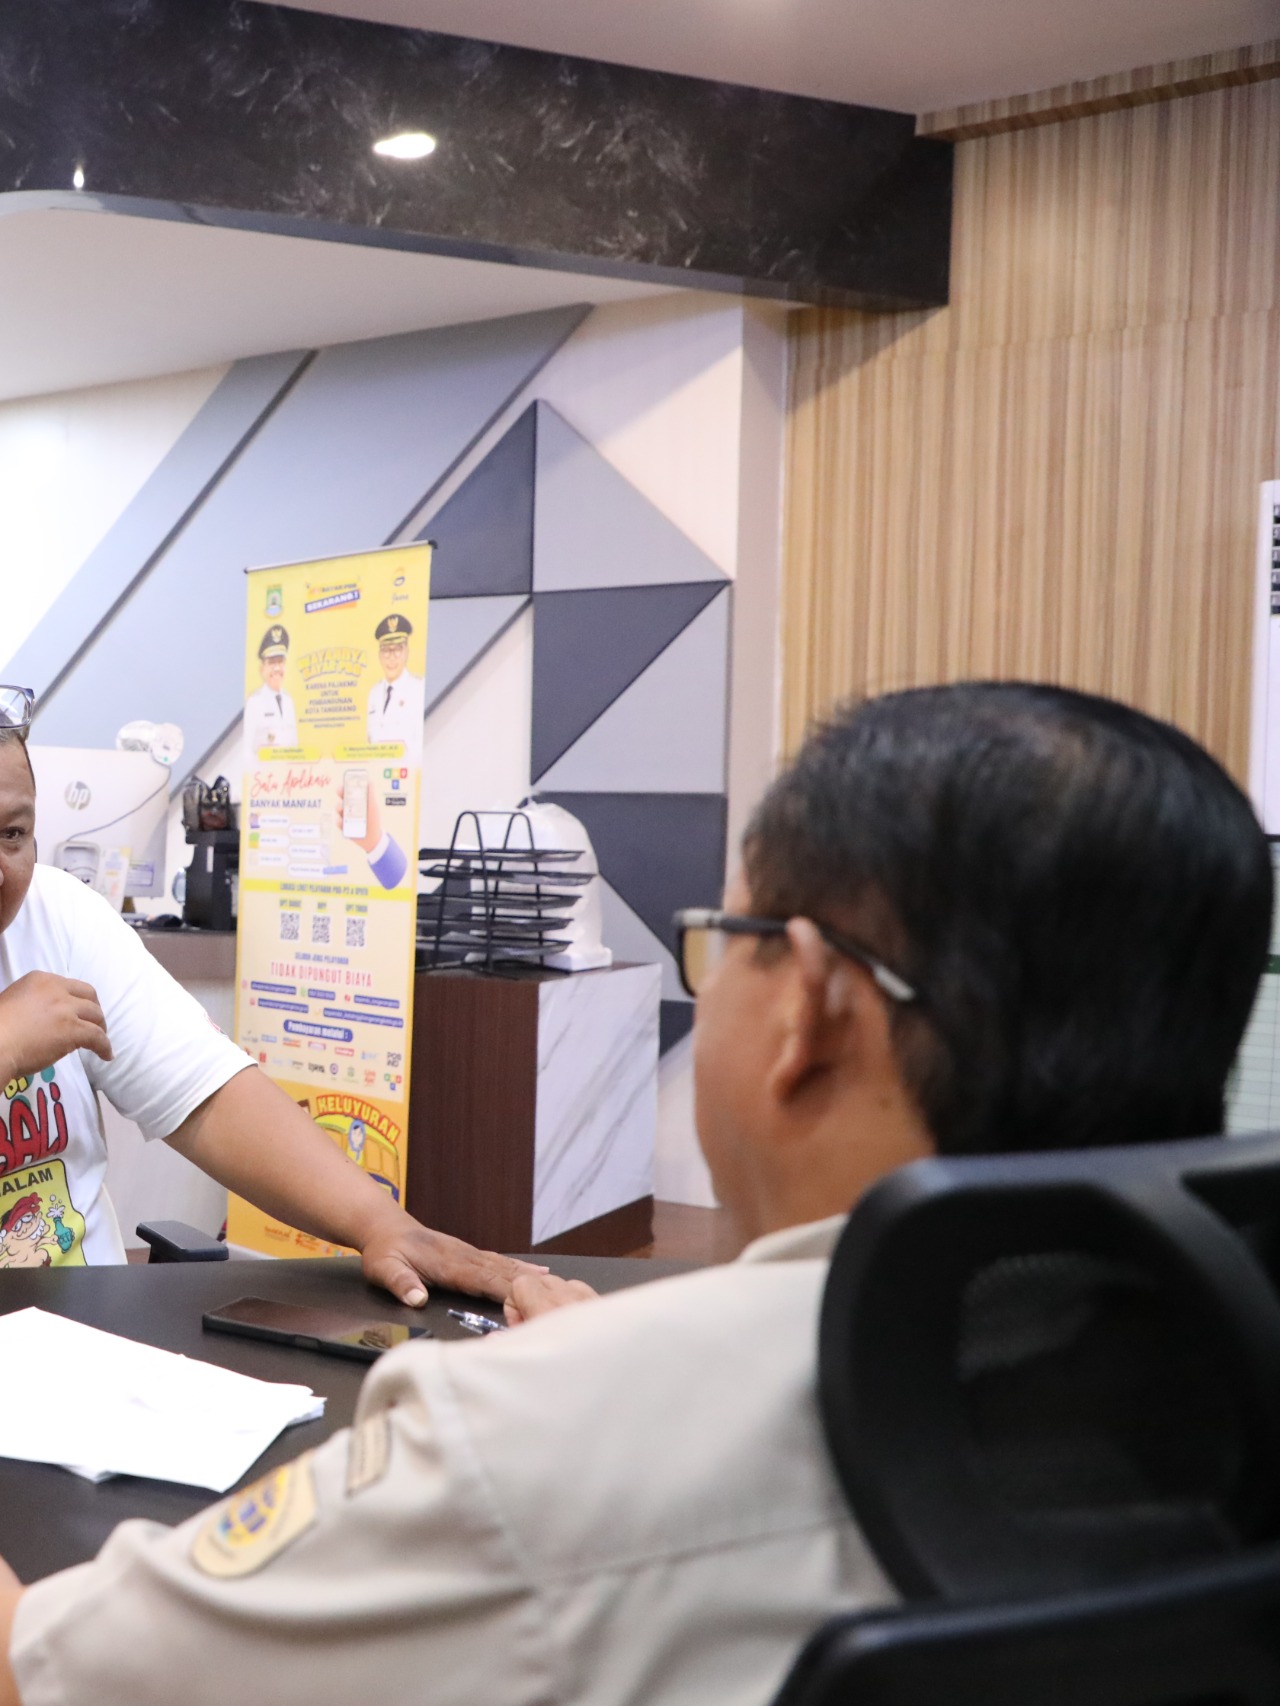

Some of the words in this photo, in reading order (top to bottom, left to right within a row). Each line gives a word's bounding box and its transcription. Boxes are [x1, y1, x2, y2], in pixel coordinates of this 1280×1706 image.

[306, 592, 354, 612] SEKARANG
[321, 705, 357, 713] TANGERANG
[281, 766, 332, 797] Aplikasi
[64, 781, 91, 810] hp
[250, 799, 281, 808] BANYAK
[282, 799, 322, 808] MANFAAT
[271, 962, 296, 979] TIDAK
[299, 965, 342, 984] DIPUNGUT
[345, 971, 372, 988] BIAYA
